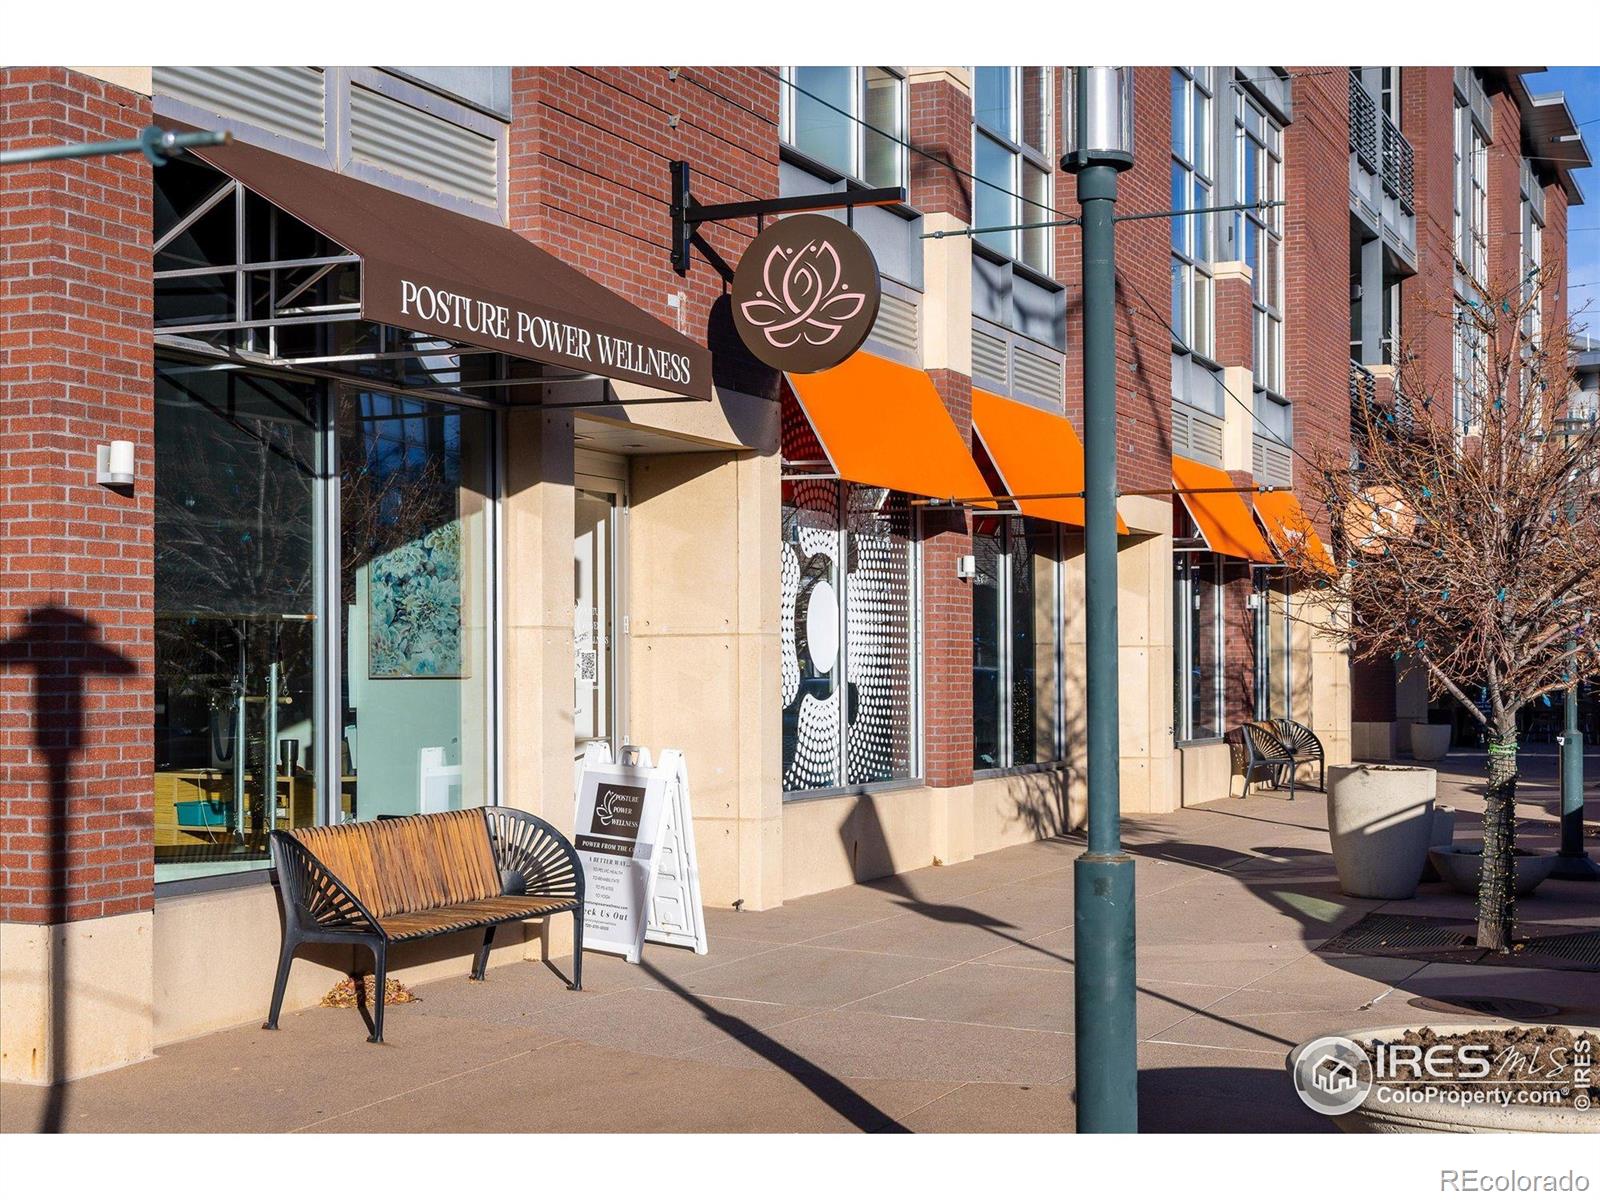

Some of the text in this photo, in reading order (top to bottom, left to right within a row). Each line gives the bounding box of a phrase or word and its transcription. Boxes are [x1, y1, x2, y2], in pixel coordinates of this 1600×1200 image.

[401, 280, 691, 385] POSTURE POWER WELLNESS
[615, 795, 639, 803] POSTURE
[613, 806, 633, 814] POWER
[611, 818, 639, 828] WELLNESS
[582, 840, 600, 849] POWER
[601, 843, 616, 851] FROM
[593, 857, 613, 865] BETTER
[600, 909, 610, 918] Us
[613, 911, 628, 921] Out
